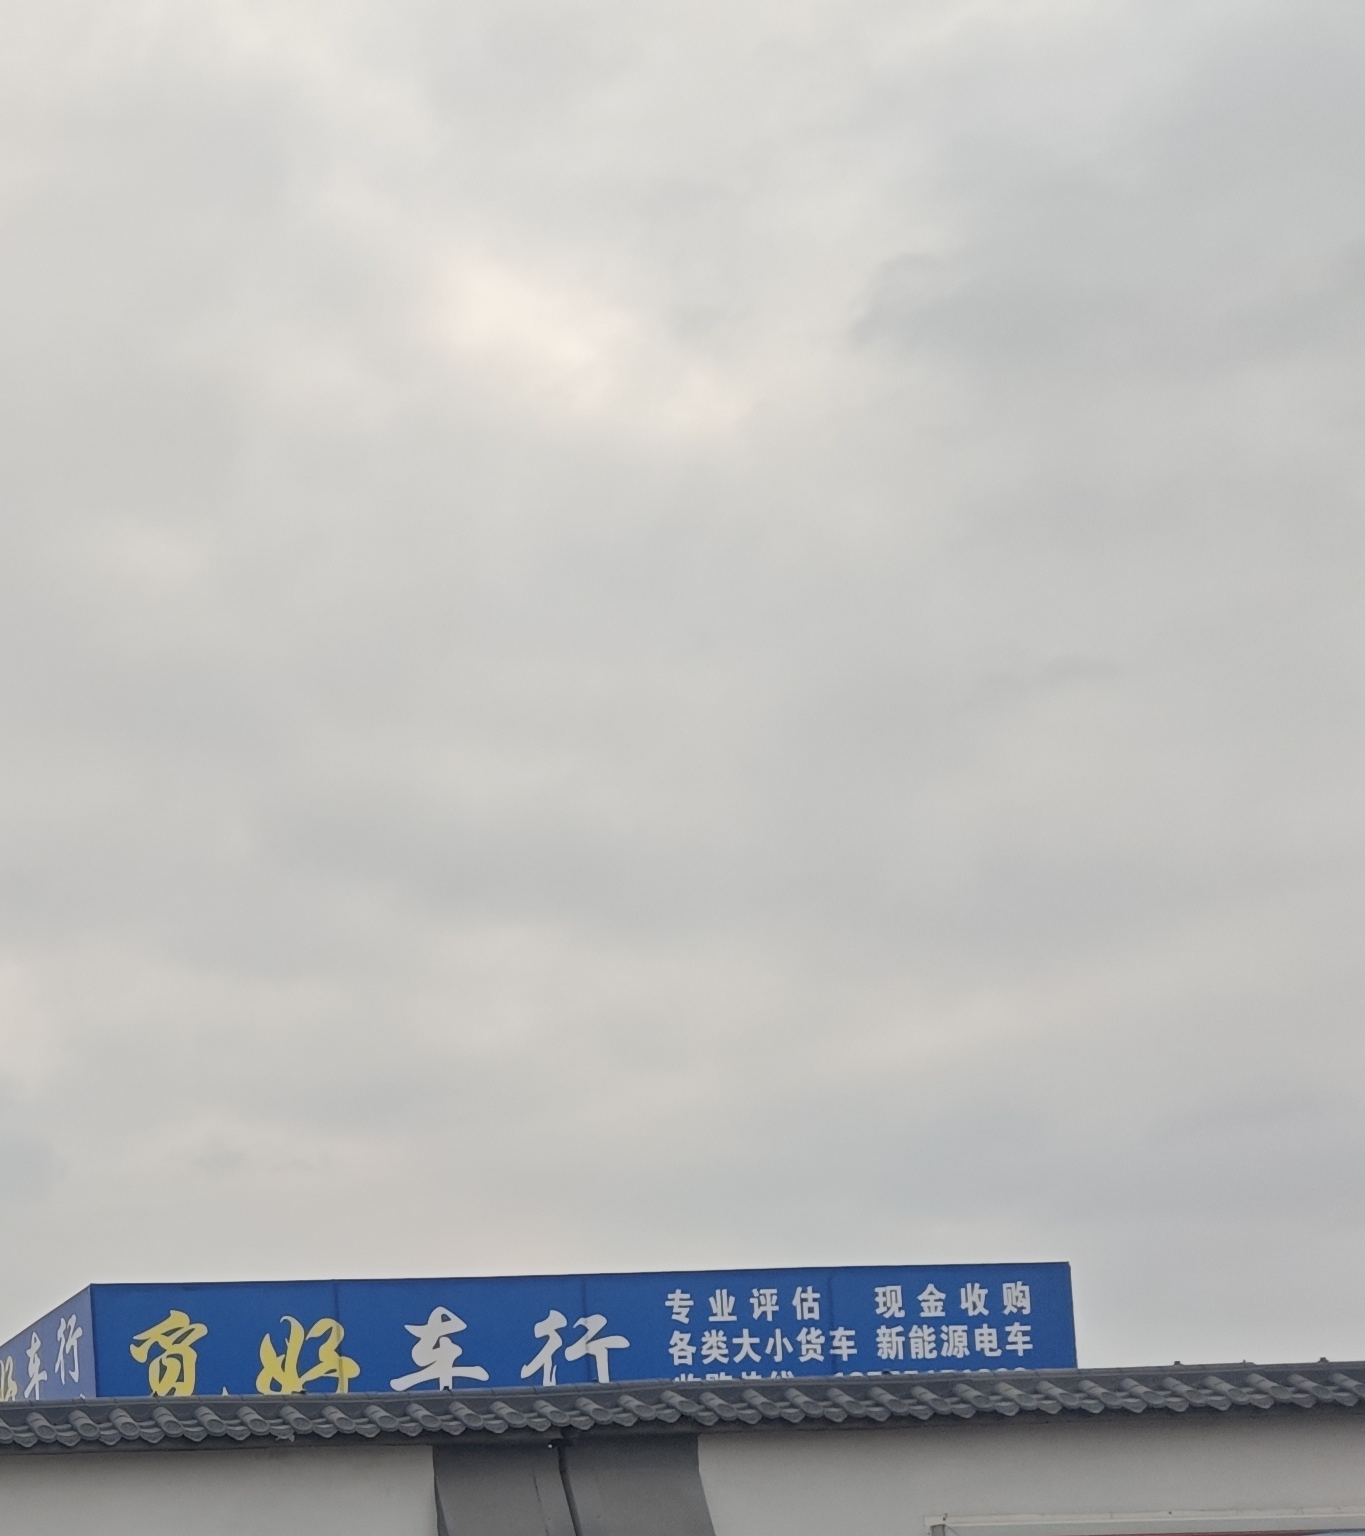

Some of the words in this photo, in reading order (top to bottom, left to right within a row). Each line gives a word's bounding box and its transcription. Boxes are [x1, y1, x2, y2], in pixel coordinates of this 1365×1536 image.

[665, 1286, 821, 1324] 专业评估
[874, 1280, 1032, 1319] 现金收购
[668, 1327, 858, 1366] 各类大小货车
[875, 1322, 1034, 1360] 新能源电车
